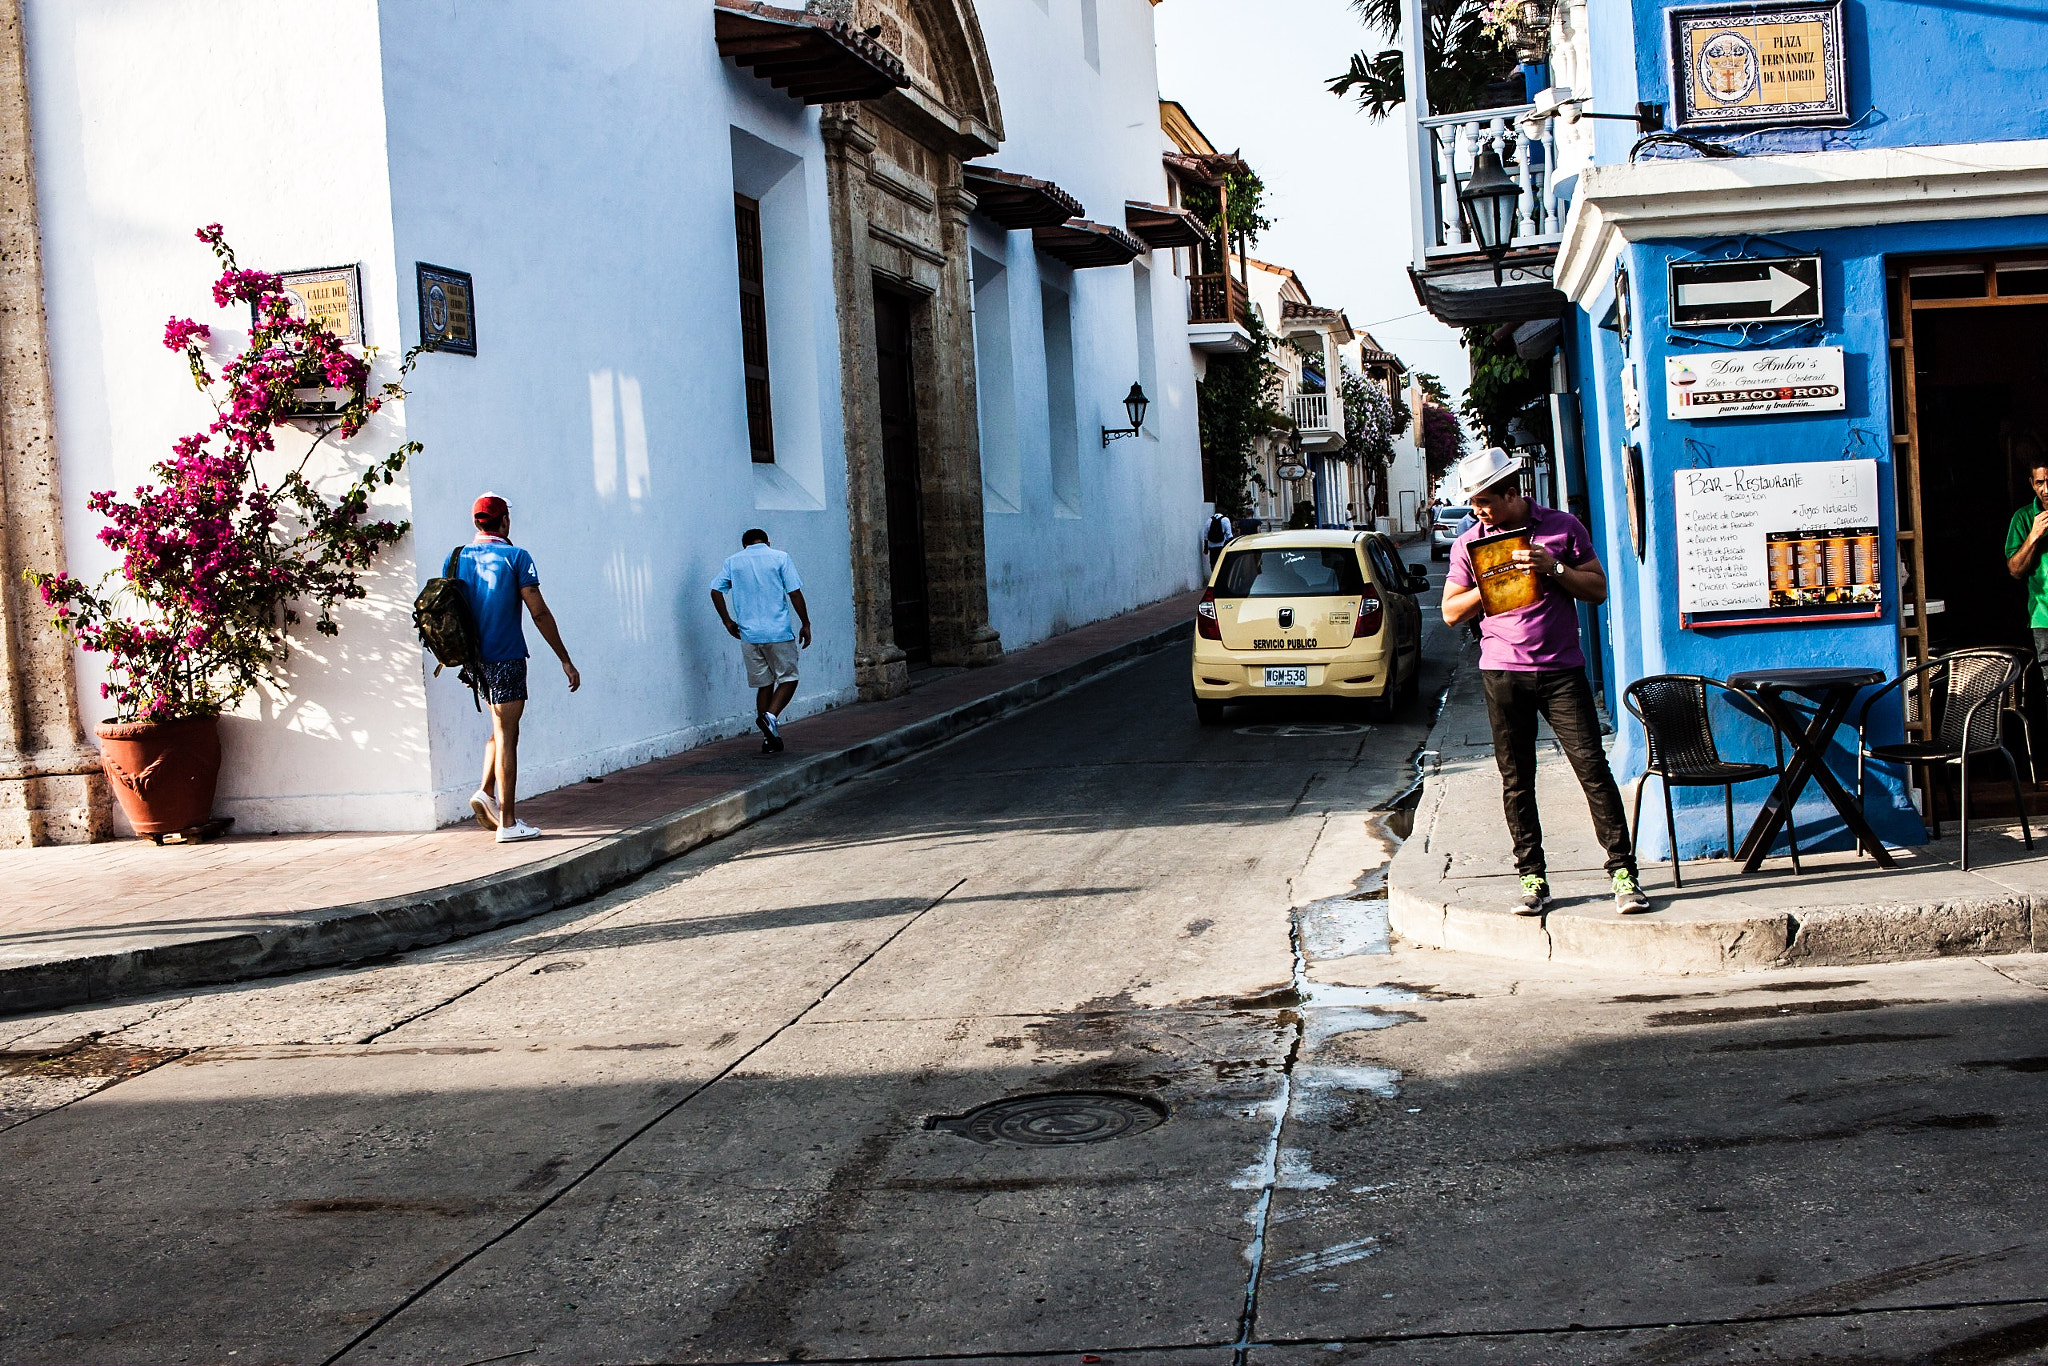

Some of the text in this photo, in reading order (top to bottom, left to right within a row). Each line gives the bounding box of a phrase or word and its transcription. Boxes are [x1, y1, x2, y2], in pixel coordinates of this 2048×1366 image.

[1773, 36, 1802, 48] PLAZA
[1762, 51, 1815, 66] FERNÁNDEZ
[1763, 69, 1815, 83] DE MADRID
[307, 286, 347, 300] CALLE DEL
[309, 303, 347, 316] SARGENTO
[322, 318, 342, 330] AYOR
[1711, 354, 1818, 374] Don Ambro's
[1705, 377, 1726, 388] Bar
[1735, 376, 1777, 387] Gourmet
[1786, 372, 1826, 384] Cocktail
[1693, 386, 1837, 403] TABACO RON
[1718, 405, 1739, 414] puro
[1740, 402, 1765, 411] sabor
[1765, 403, 1773, 411] y
[1798, 504, 1819, 519] Jugos
[528, 562, 536, 577] 4
[1253, 638, 1318, 648] SERVICIO PUBLICO
